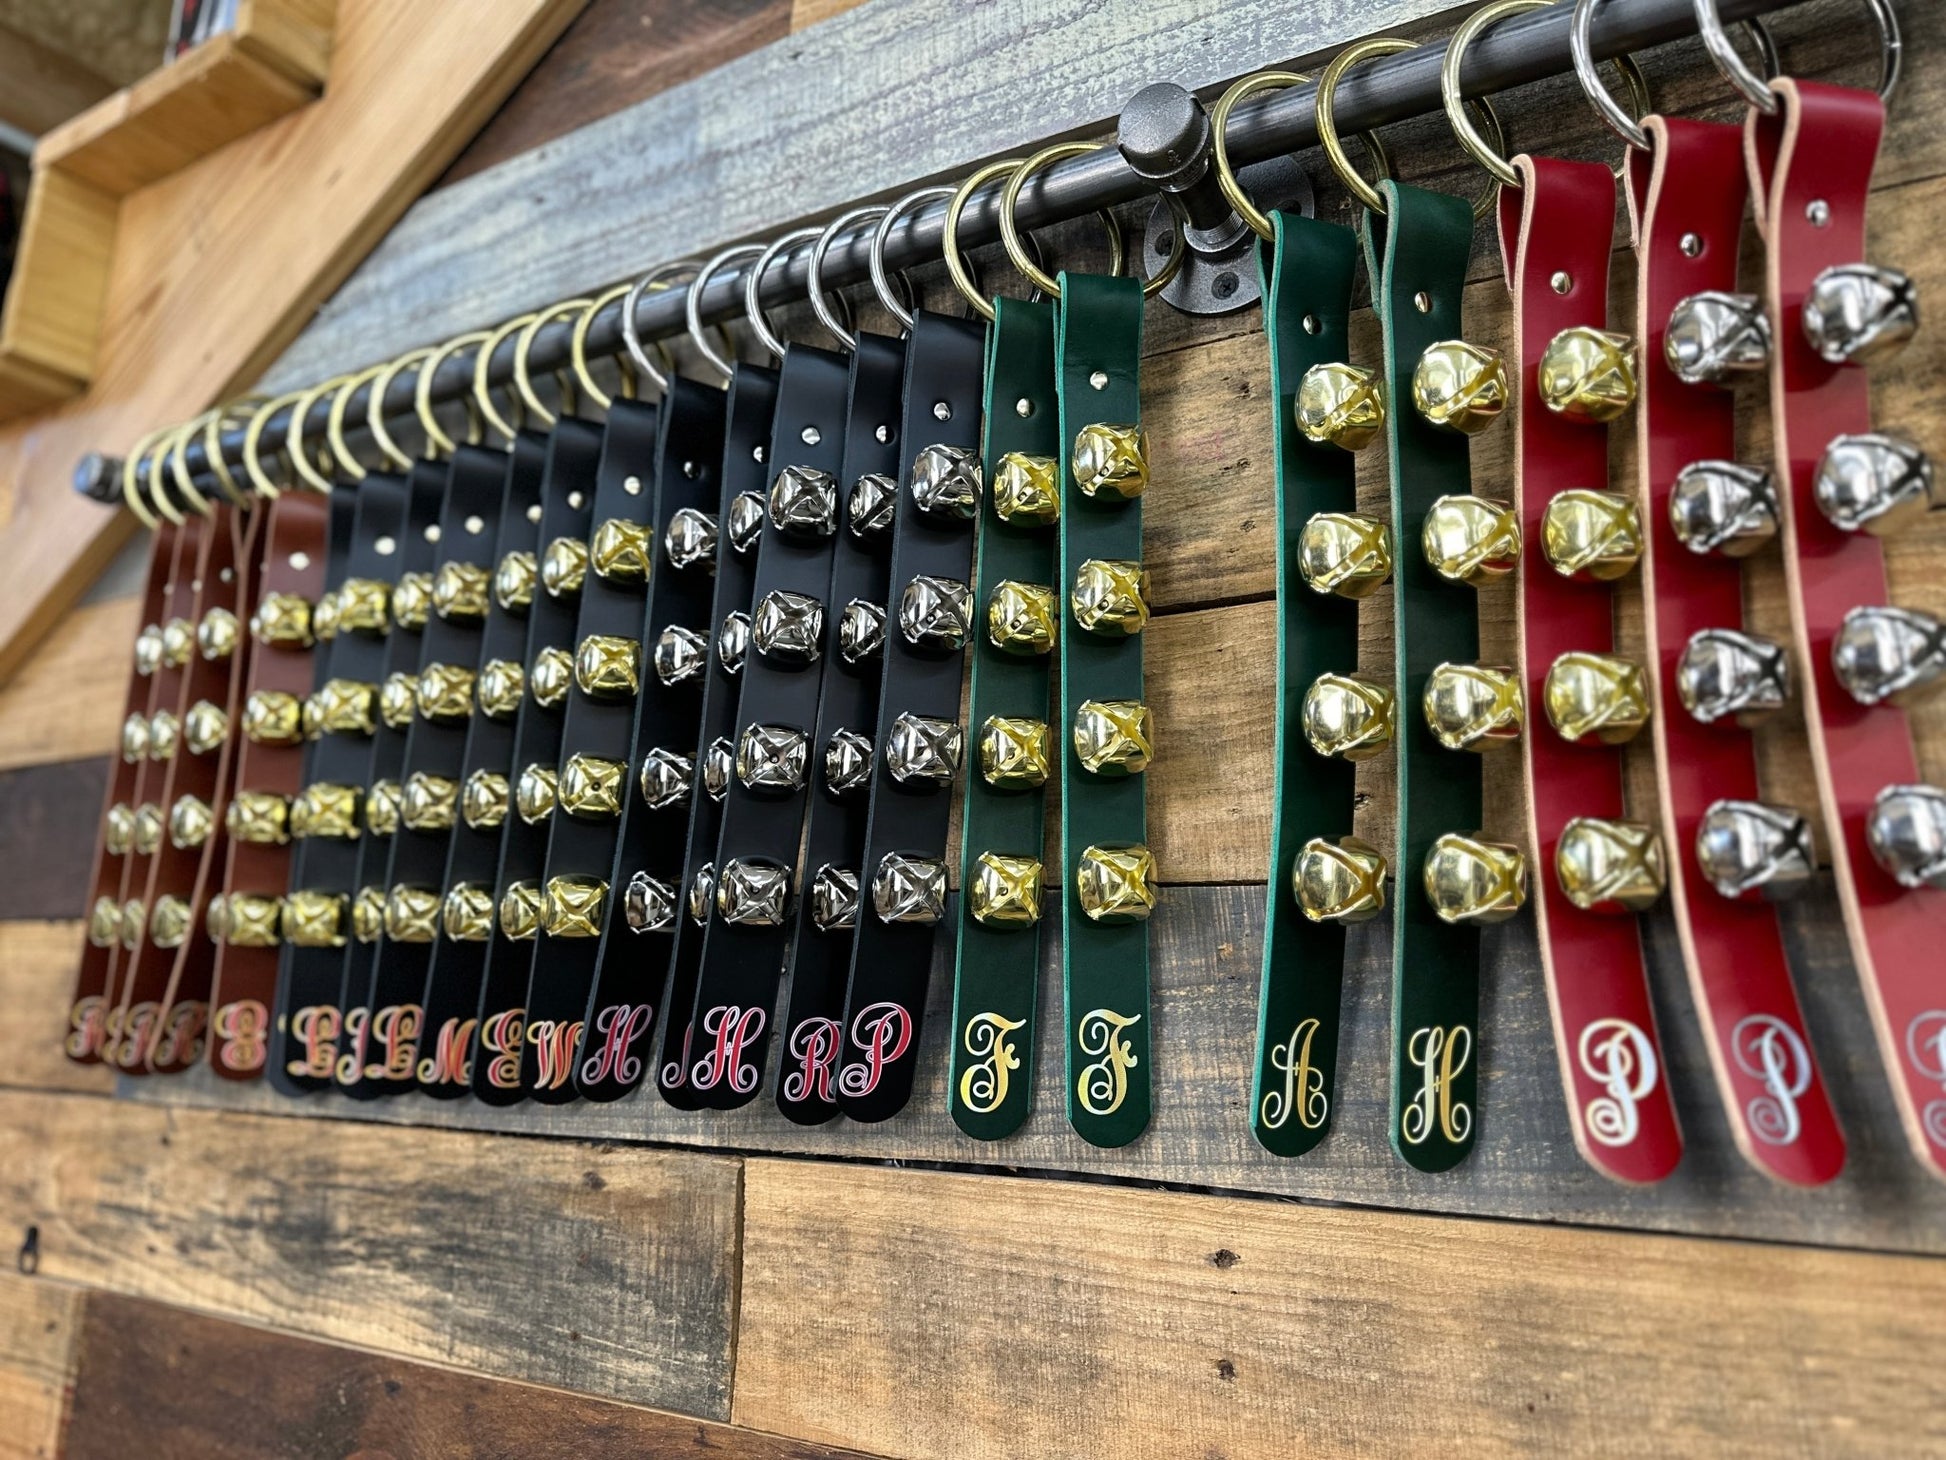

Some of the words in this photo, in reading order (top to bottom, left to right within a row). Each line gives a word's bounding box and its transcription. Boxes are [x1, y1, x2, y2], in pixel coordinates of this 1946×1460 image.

[526, 1020, 584, 1090] W
[581, 1004, 653, 1086] H
[691, 1005, 766, 1093] H
[784, 1016, 843, 1103] R
[838, 1001, 912, 1098] P
[959, 1011, 1027, 1113] F
[1077, 1008, 1142, 1116] F
[1261, 1017, 1328, 1130] A
[1402, 1024, 1473, 1145] H
[1578, 1017, 1658, 1147] P
[1731, 1013, 1812, 1146] P
